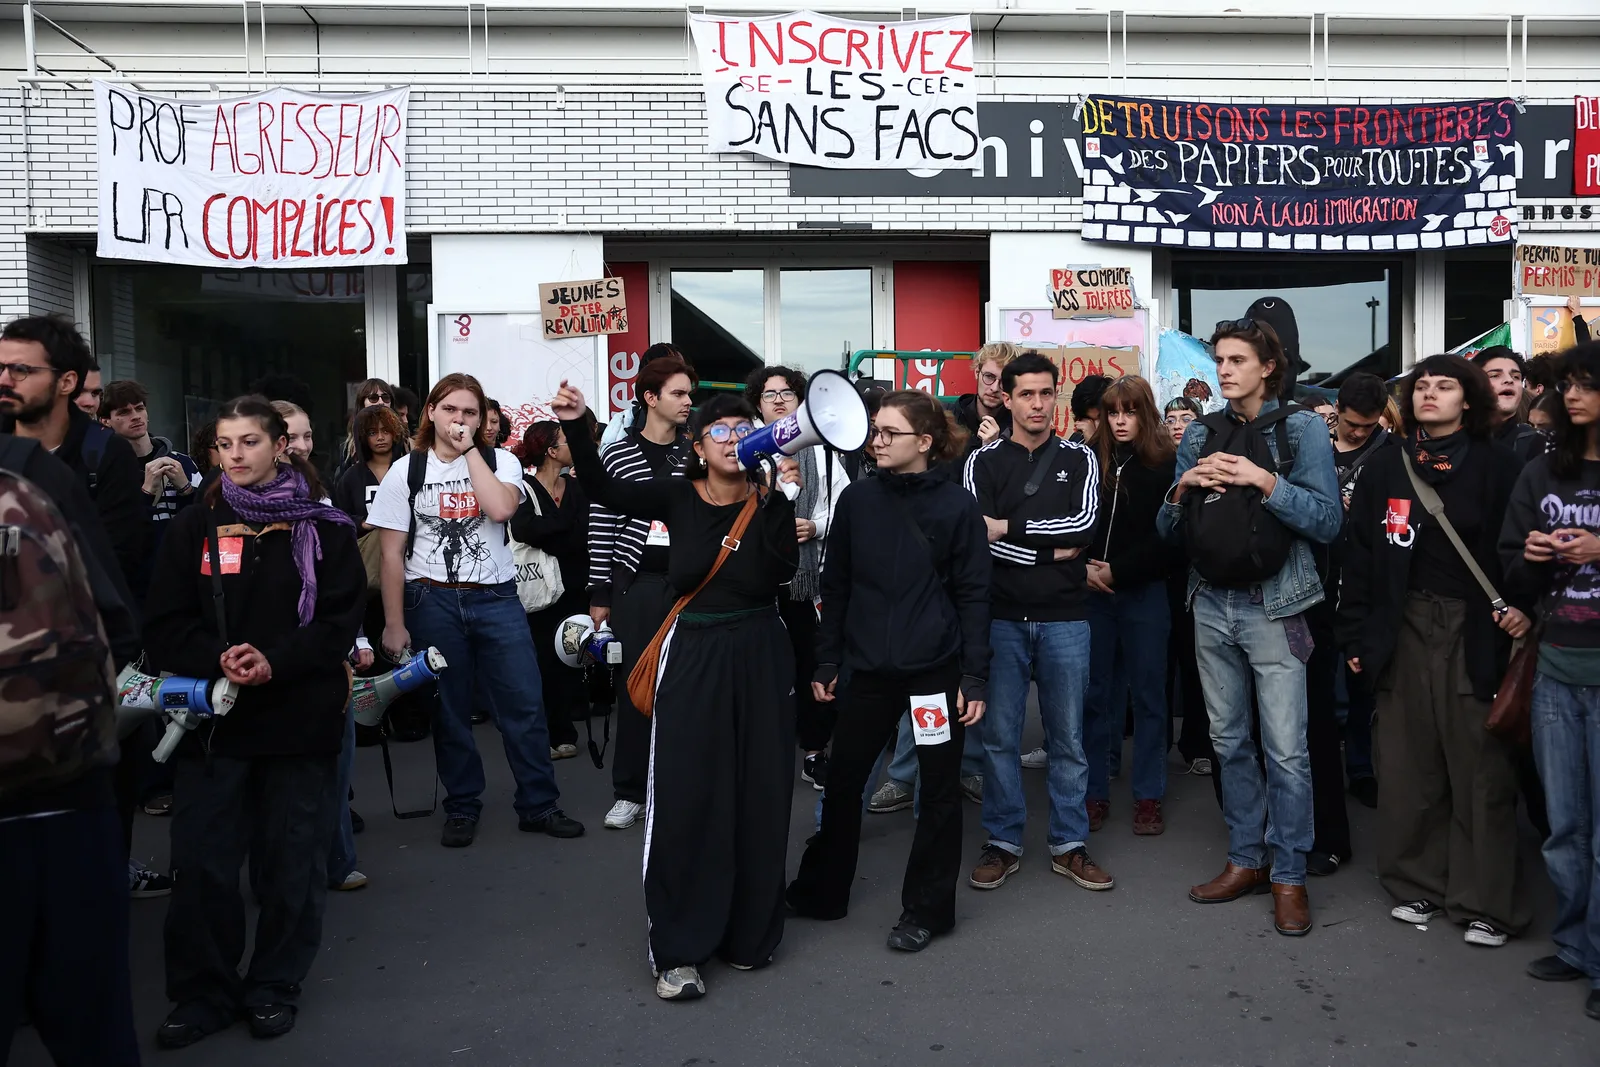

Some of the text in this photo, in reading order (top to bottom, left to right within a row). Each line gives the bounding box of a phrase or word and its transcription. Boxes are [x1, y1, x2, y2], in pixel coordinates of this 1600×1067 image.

[725, 82, 978, 161] SANS FACS
[1280, 108, 1327, 139] LES
[1576, 97, 1600, 130] DE
[108, 89, 402, 179] PROF AGRESSEUR
[1128, 149, 1169, 170] DES
[1173, 141, 1321, 187] PAPIERS
[1323, 156, 1365, 178] POUR
[113, 181, 189, 250] UFR
[1211, 202, 1249, 226] NON
[1250, 196, 1268, 227] À
[1271, 201, 1291, 227] LA
[1564, 247, 1579, 264] DE
[547, 279, 620, 305] JEUNES
[1052, 269, 1073, 290] P8
[558, 302, 603, 318] DETER
[1053, 288, 1080, 311] VSS
